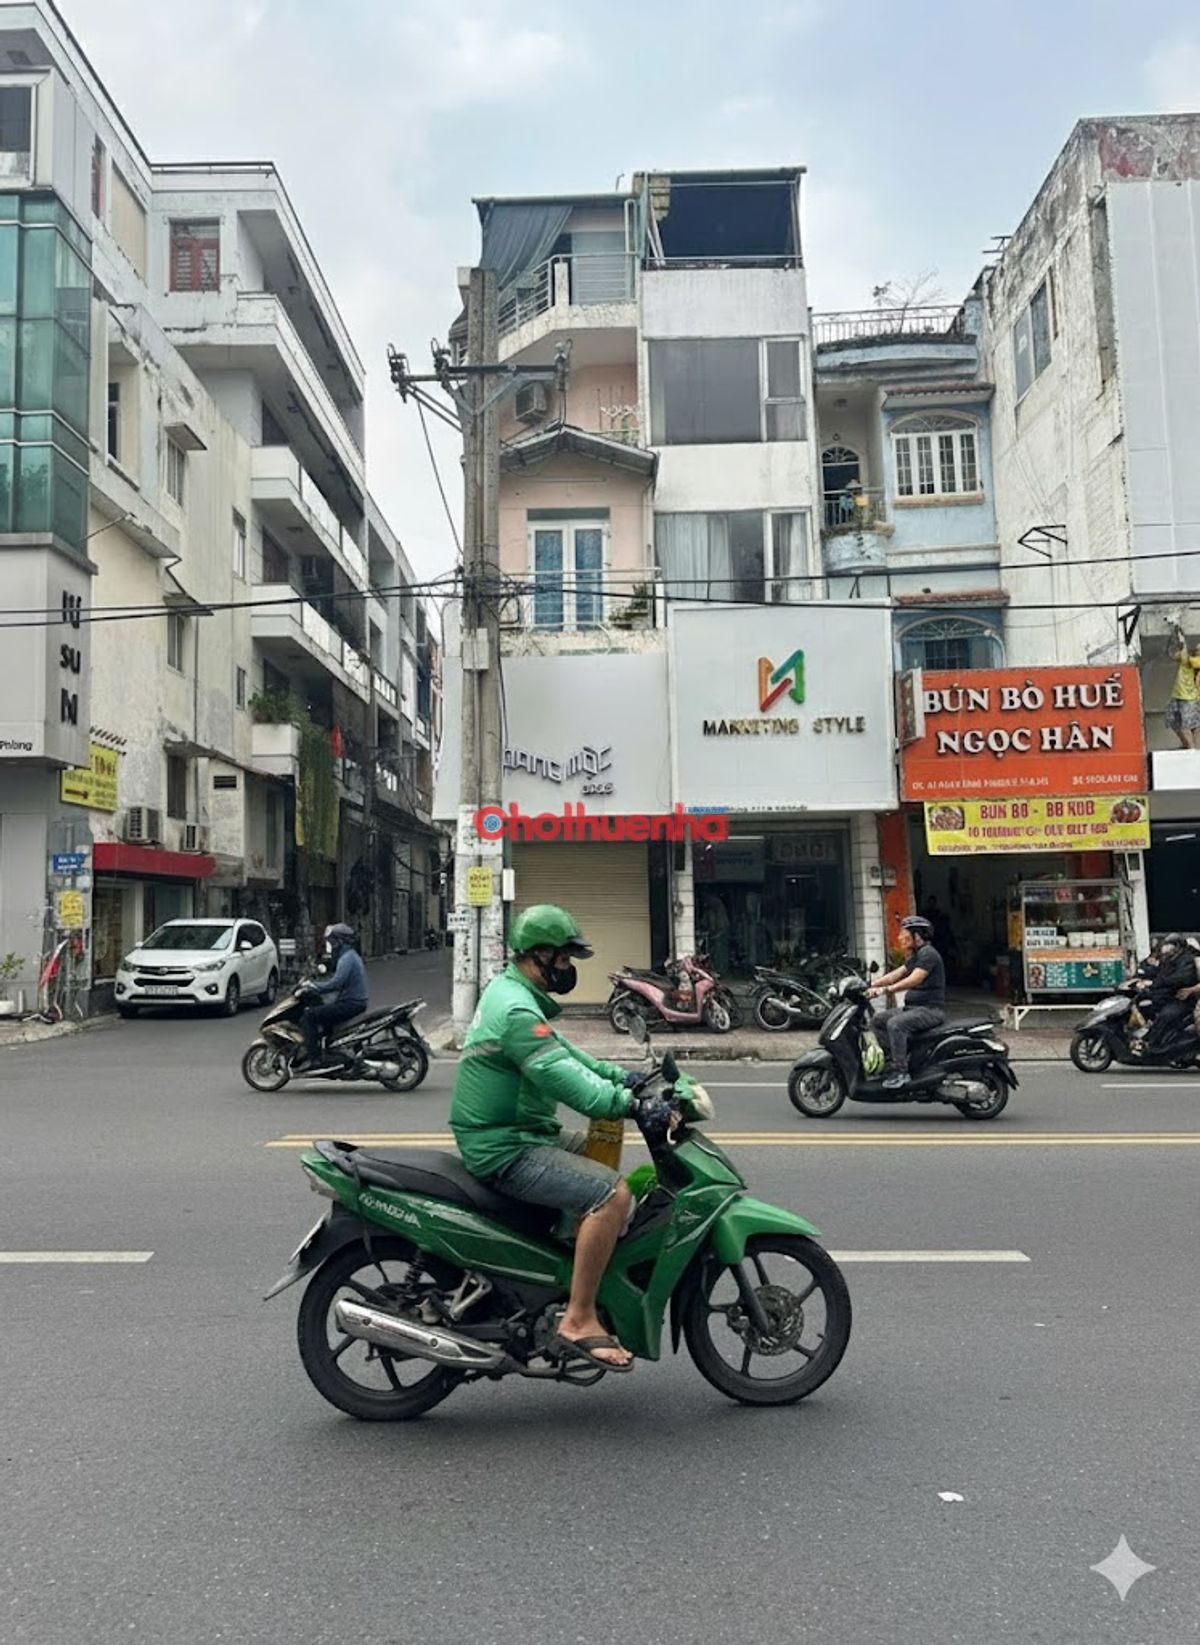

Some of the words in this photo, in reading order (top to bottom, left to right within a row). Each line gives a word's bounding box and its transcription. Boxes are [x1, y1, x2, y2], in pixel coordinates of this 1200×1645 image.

[922, 682, 991, 714] BÚN
[1000, 679, 1045, 711] BÒ
[1053, 672, 1124, 709] HUẾ
[812, 716, 865, 734] STYLE
[936, 728, 1032, 759] NGỌC
[1040, 719, 1114, 751] HÂN
